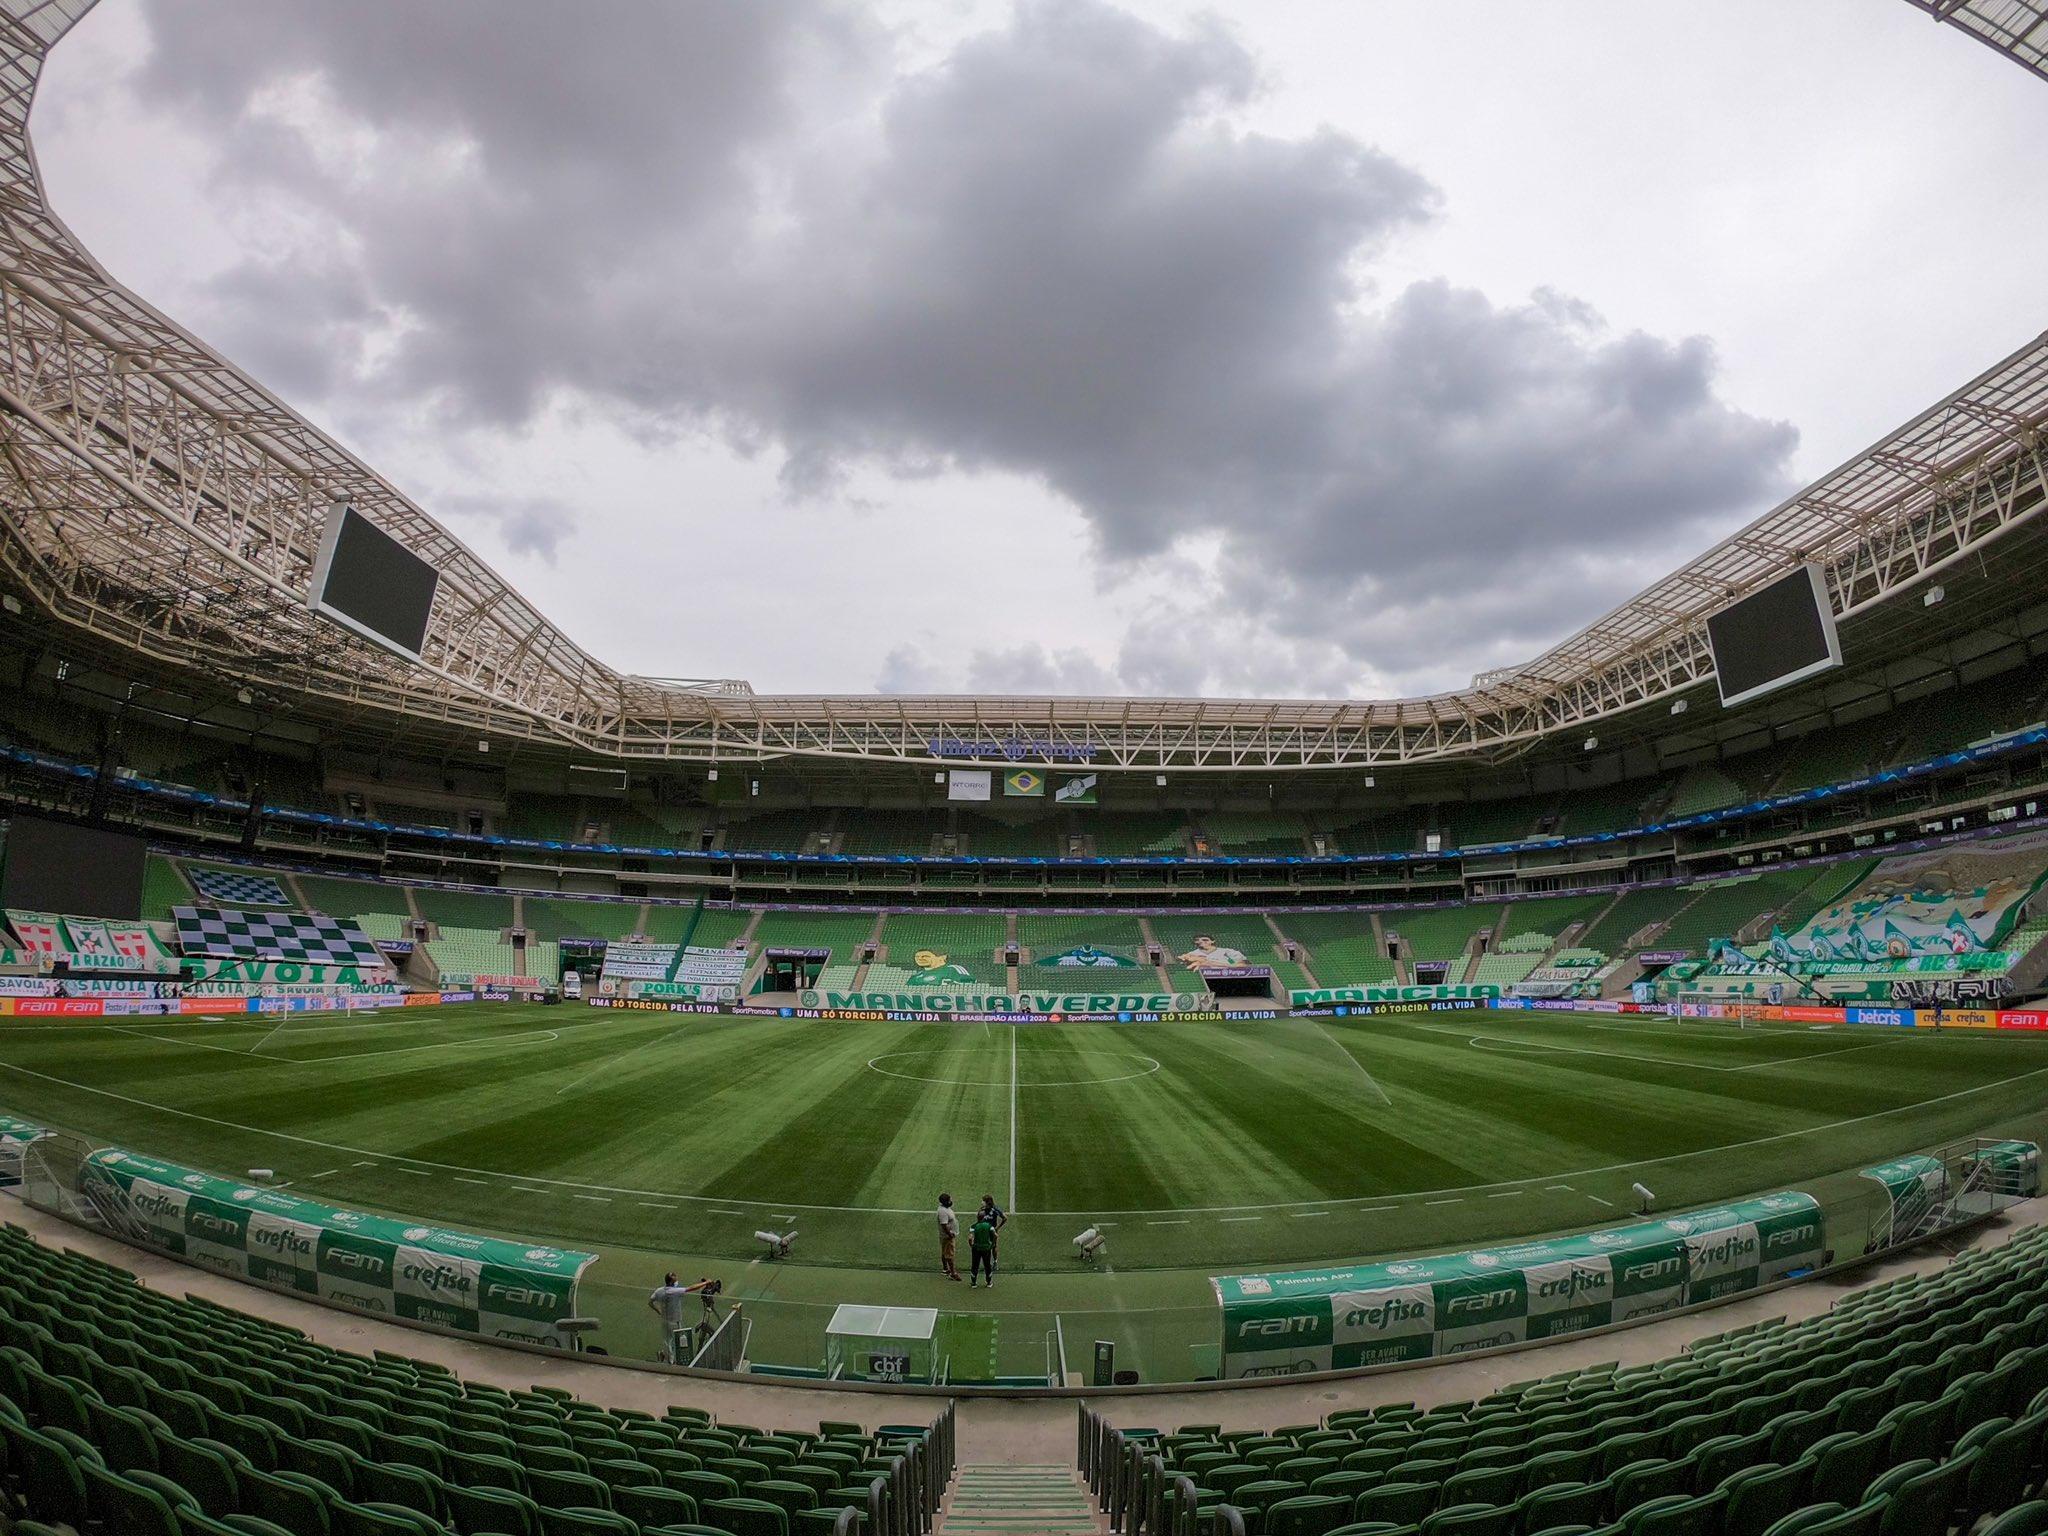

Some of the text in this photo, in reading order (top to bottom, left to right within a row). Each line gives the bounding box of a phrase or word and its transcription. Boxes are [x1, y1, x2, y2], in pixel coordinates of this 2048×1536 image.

[180, 957, 360, 986] SAVOIA
[78, 979, 147, 992] SAVOIA
[481, 991, 509, 1002] bodog
[826, 991, 1172, 1012] MANCHA VERDE
[1291, 984, 1500, 1006] MANCHA
[590, 998, 720, 1014] UMA SÓ TORCIDA PELA VIDA
[732, 1006, 778, 1016] SportPromotion
[1288, 1008, 1334, 1017] SportPromotion
[1351, 1001, 1476, 1015] UMA SÓ TORCIDA PELA VIDA
[797, 1009, 940, 1022] UMA SÓ TORCIDA PELA VIDA
[959, 1013, 1007, 1022] BRASILEIRÃO
[1029, 1014, 1048, 1022] 2020
[1067, 1014, 1116, 1022] SportPromotion
[1136, 1010, 1276, 1022] UMA SÓ TORCIDA PELA VIDA
[1858, 1008, 1901, 1026] betcris
[1956, 1011, 1986, 1026] crefisa
[255, 1225, 312, 1255] crefisa
[403, 1263, 472, 1293] crefisa
[1539, 1267, 1607, 1299] crefisa
[1345, 1299, 1427, 1330] crefisa
[874, 1357, 903, 1374] cbf
